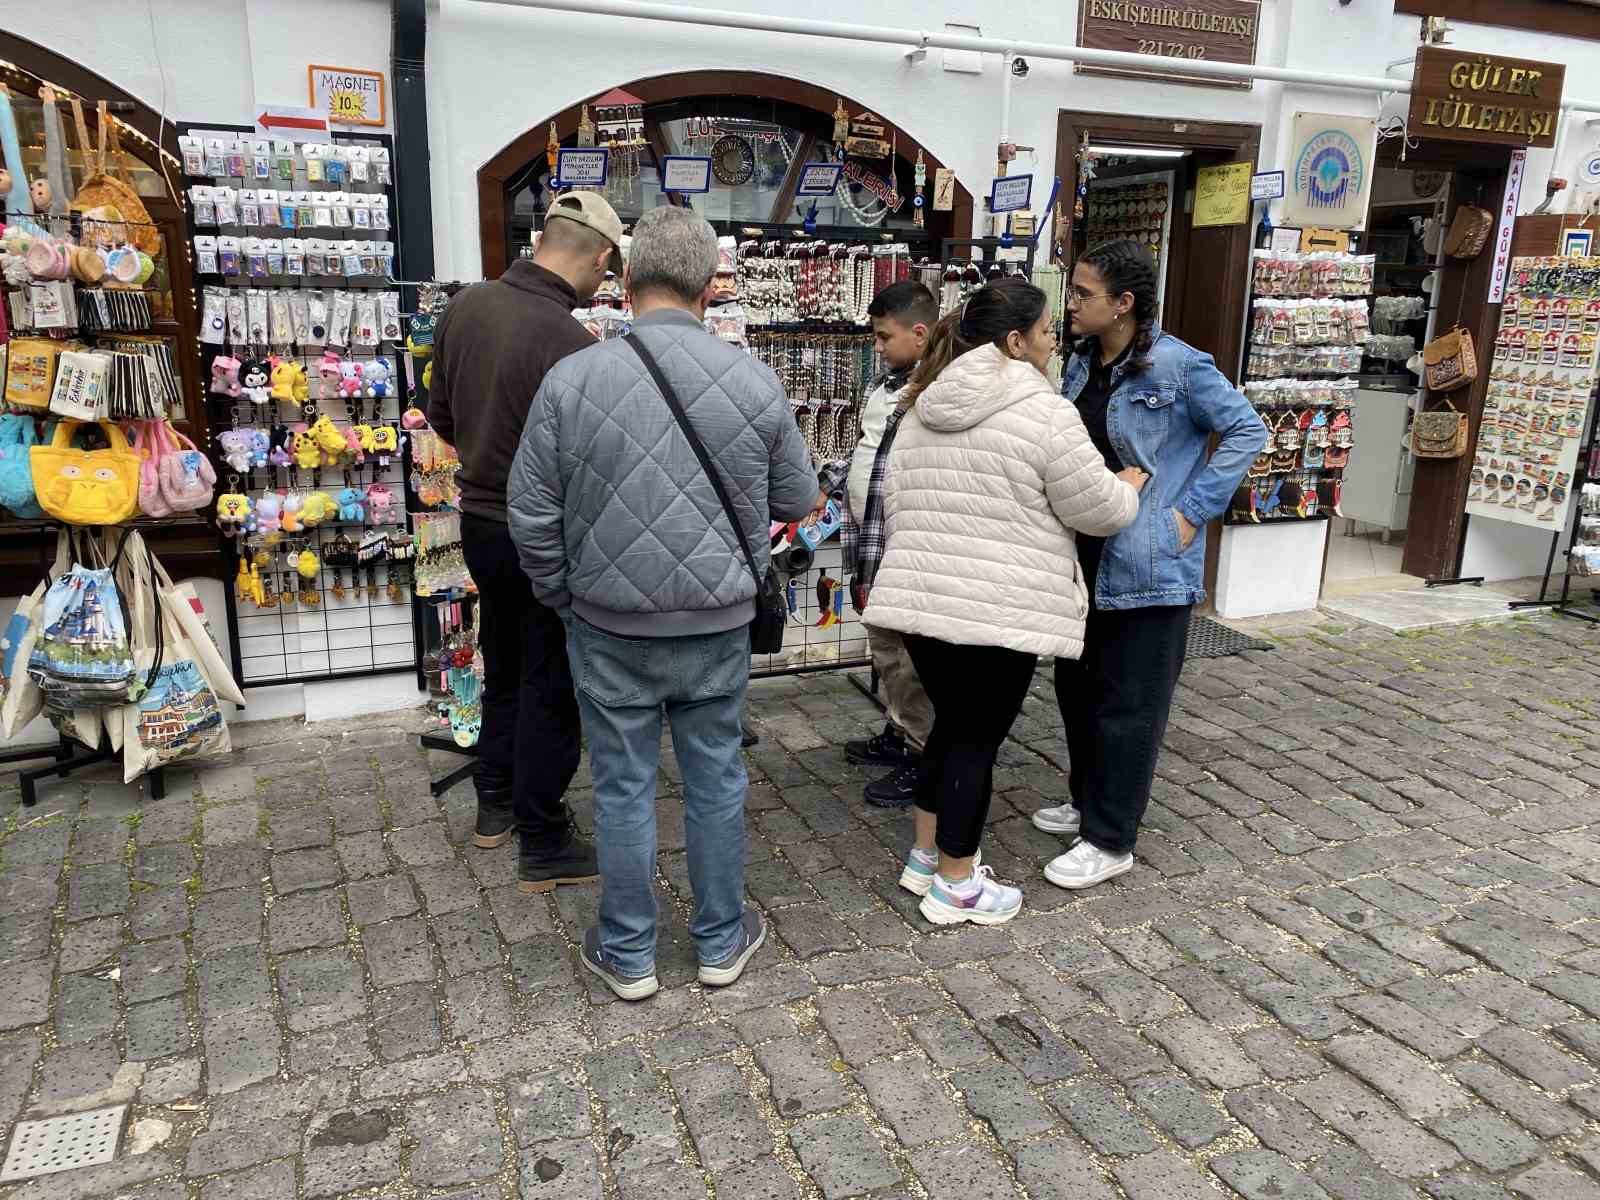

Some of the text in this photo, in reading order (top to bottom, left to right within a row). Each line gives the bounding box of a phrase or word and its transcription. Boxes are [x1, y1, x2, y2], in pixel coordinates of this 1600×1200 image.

[1089, 0, 1252, 40] ESKİŞEHİR LÜLETAŞI
[1137, 39, 1206, 60] 221 72 02
[321, 71, 381, 92] MAGNET
[1449, 56, 1543, 97] GÜLER
[1421, 94, 1553, 143] LÜLETAŞI
